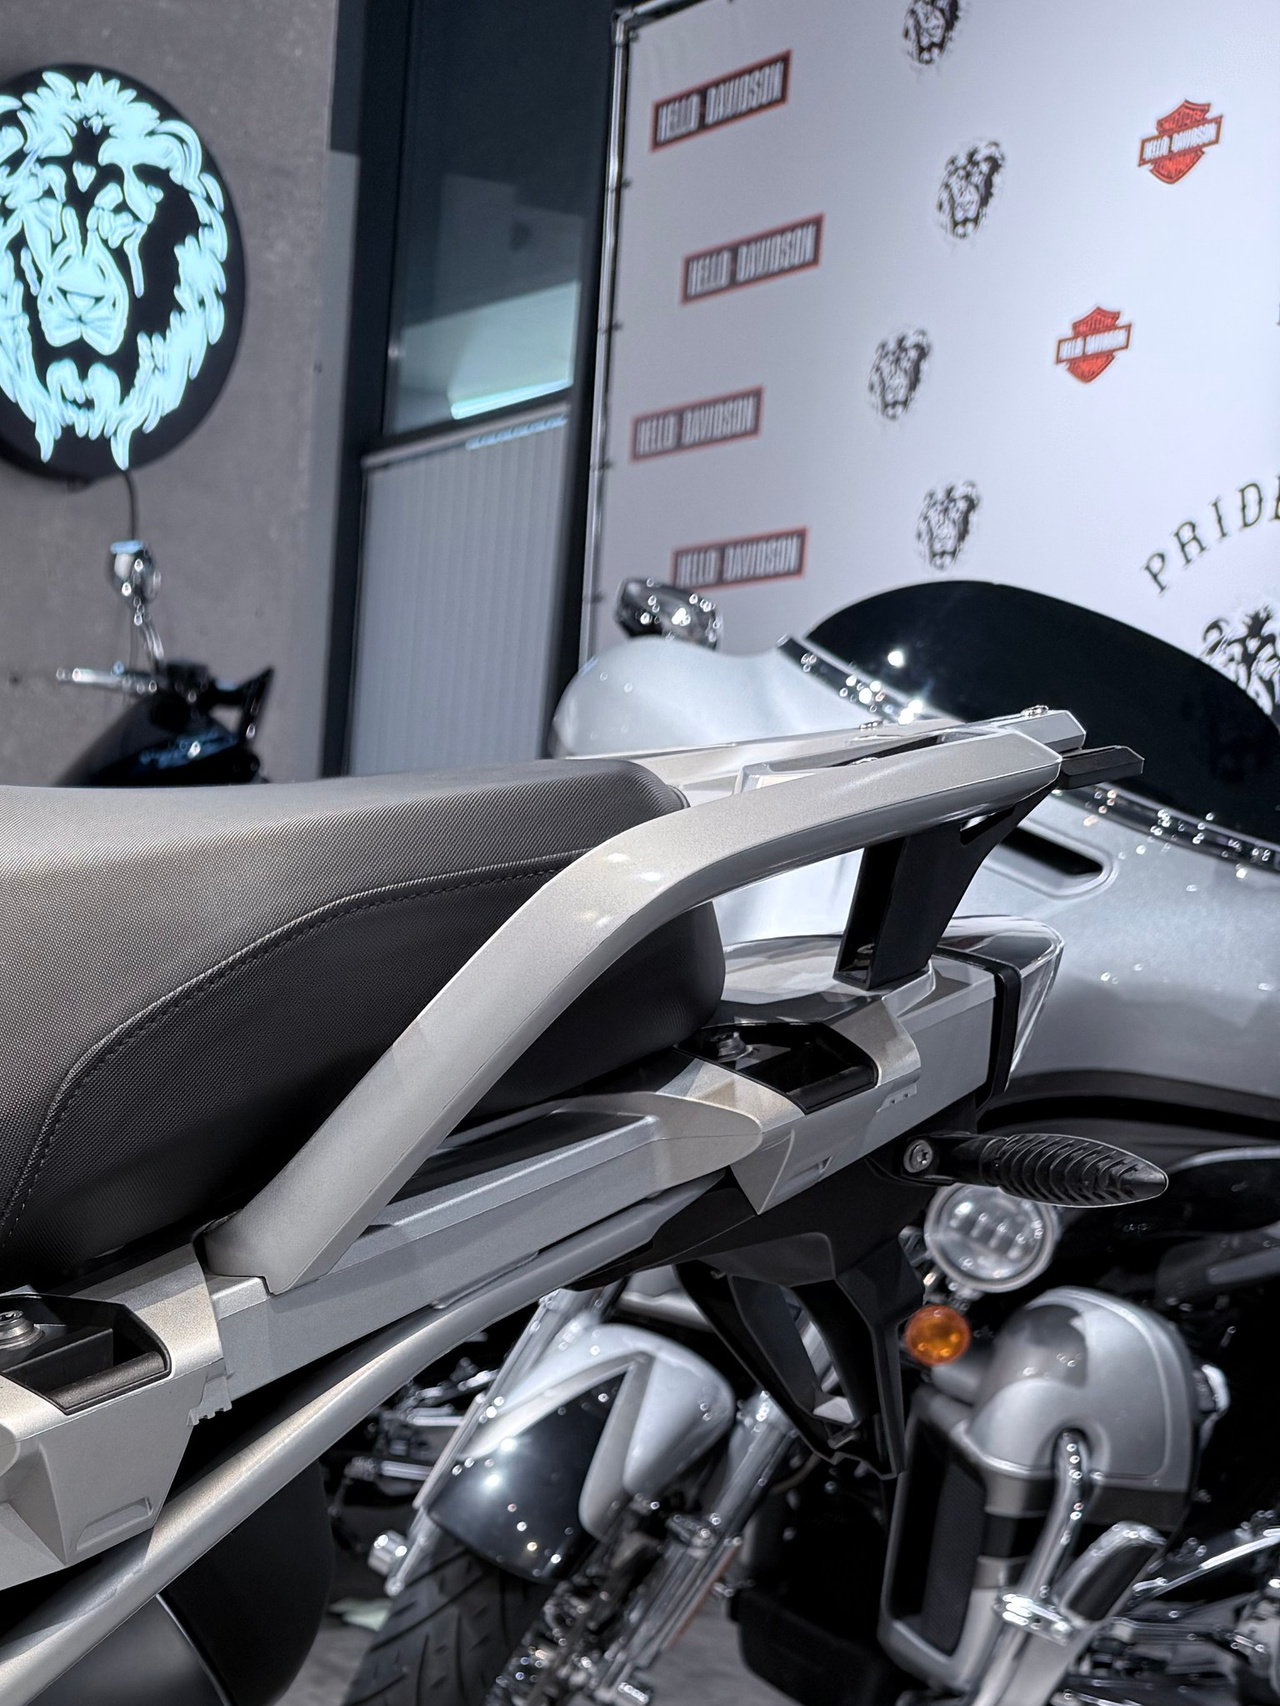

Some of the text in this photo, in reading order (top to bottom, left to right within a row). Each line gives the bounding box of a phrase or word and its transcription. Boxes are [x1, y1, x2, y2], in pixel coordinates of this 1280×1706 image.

[656, 60, 785, 144] HELLO DAVIDSON
[1143, 475, 1280, 594] PRID
